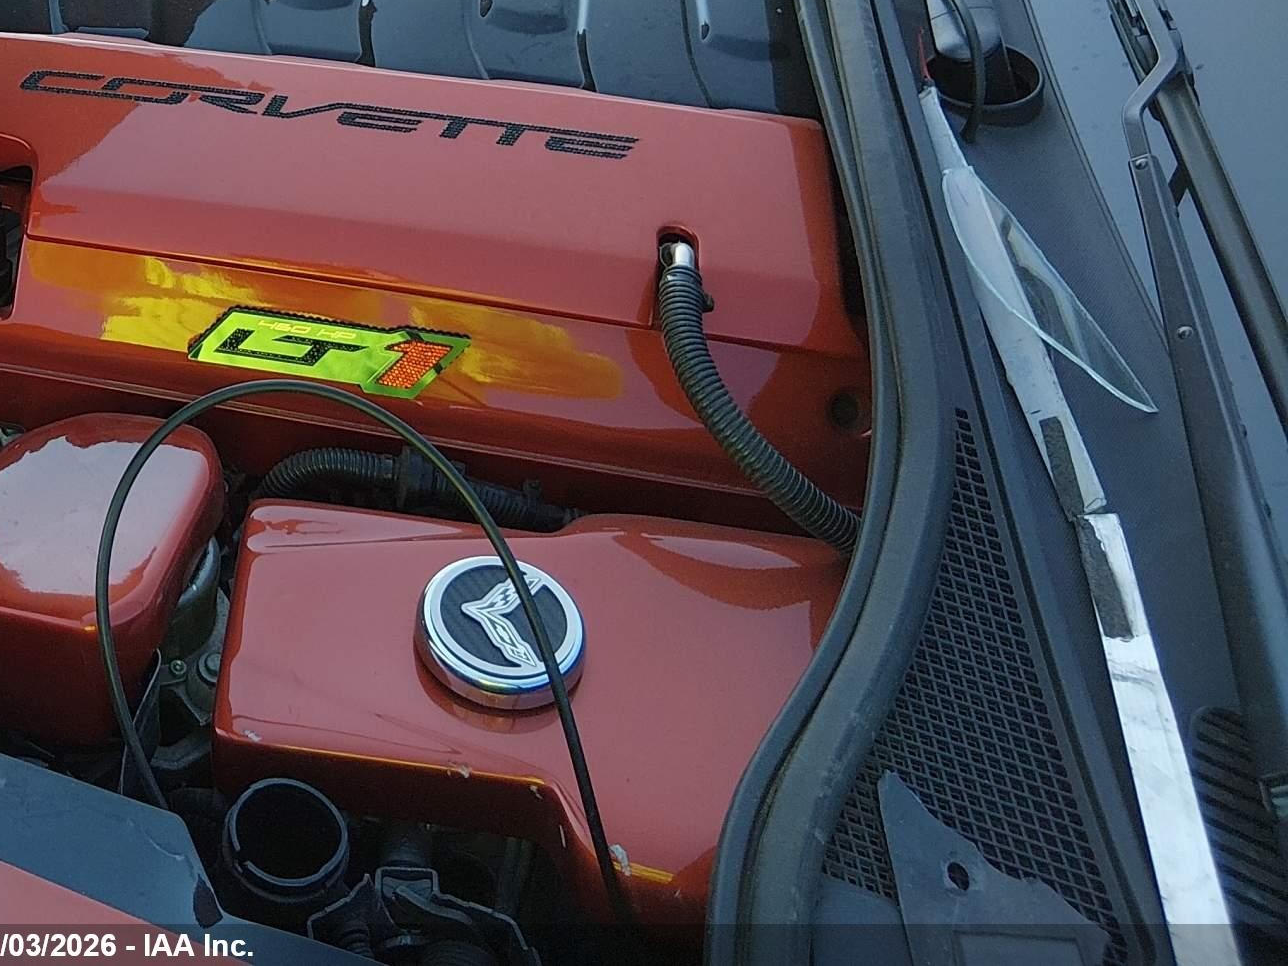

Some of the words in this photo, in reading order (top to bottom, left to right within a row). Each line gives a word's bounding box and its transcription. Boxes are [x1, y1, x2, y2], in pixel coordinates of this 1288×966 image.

[20, 69, 639, 160] CORVETTE
[213, 328, 452, 389] LT1
[258, 320, 312, 334] 460
[316, 329, 357, 339] HP
